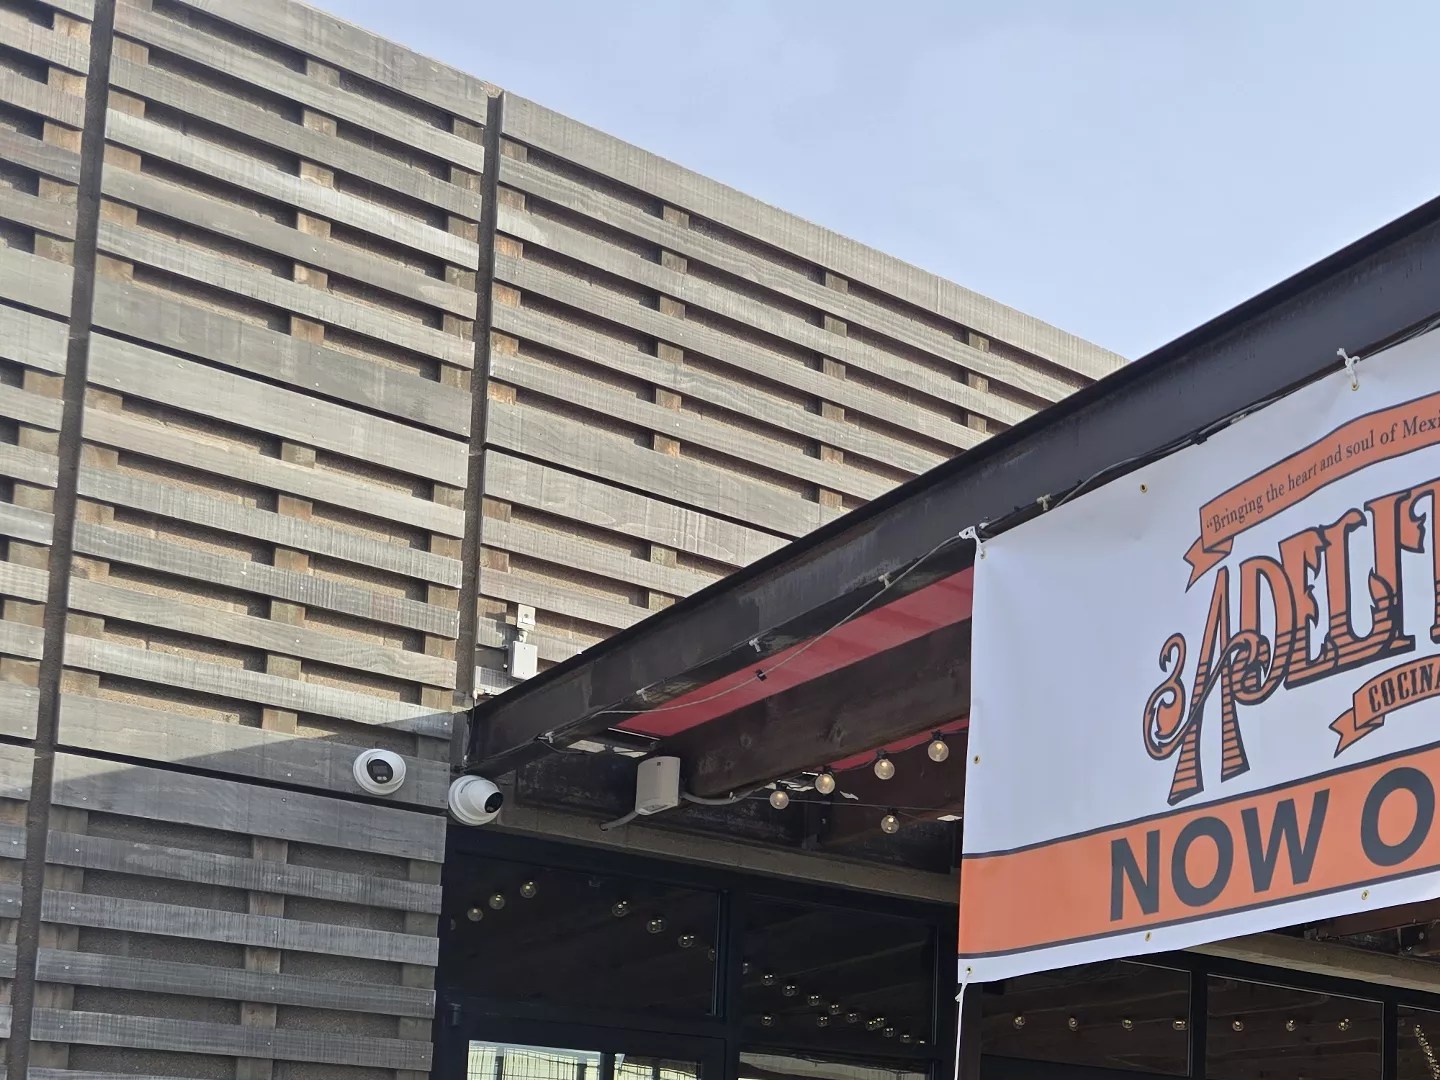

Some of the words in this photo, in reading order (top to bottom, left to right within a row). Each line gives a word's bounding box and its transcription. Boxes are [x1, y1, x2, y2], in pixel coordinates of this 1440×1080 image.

[1265, 482, 1286, 503] the
[1287, 464, 1318, 493] heart
[1319, 449, 1343, 477] and
[1345, 430, 1375, 460] soul
[1379, 423, 1398, 445] of
[1108, 788, 1332, 923] NOW
